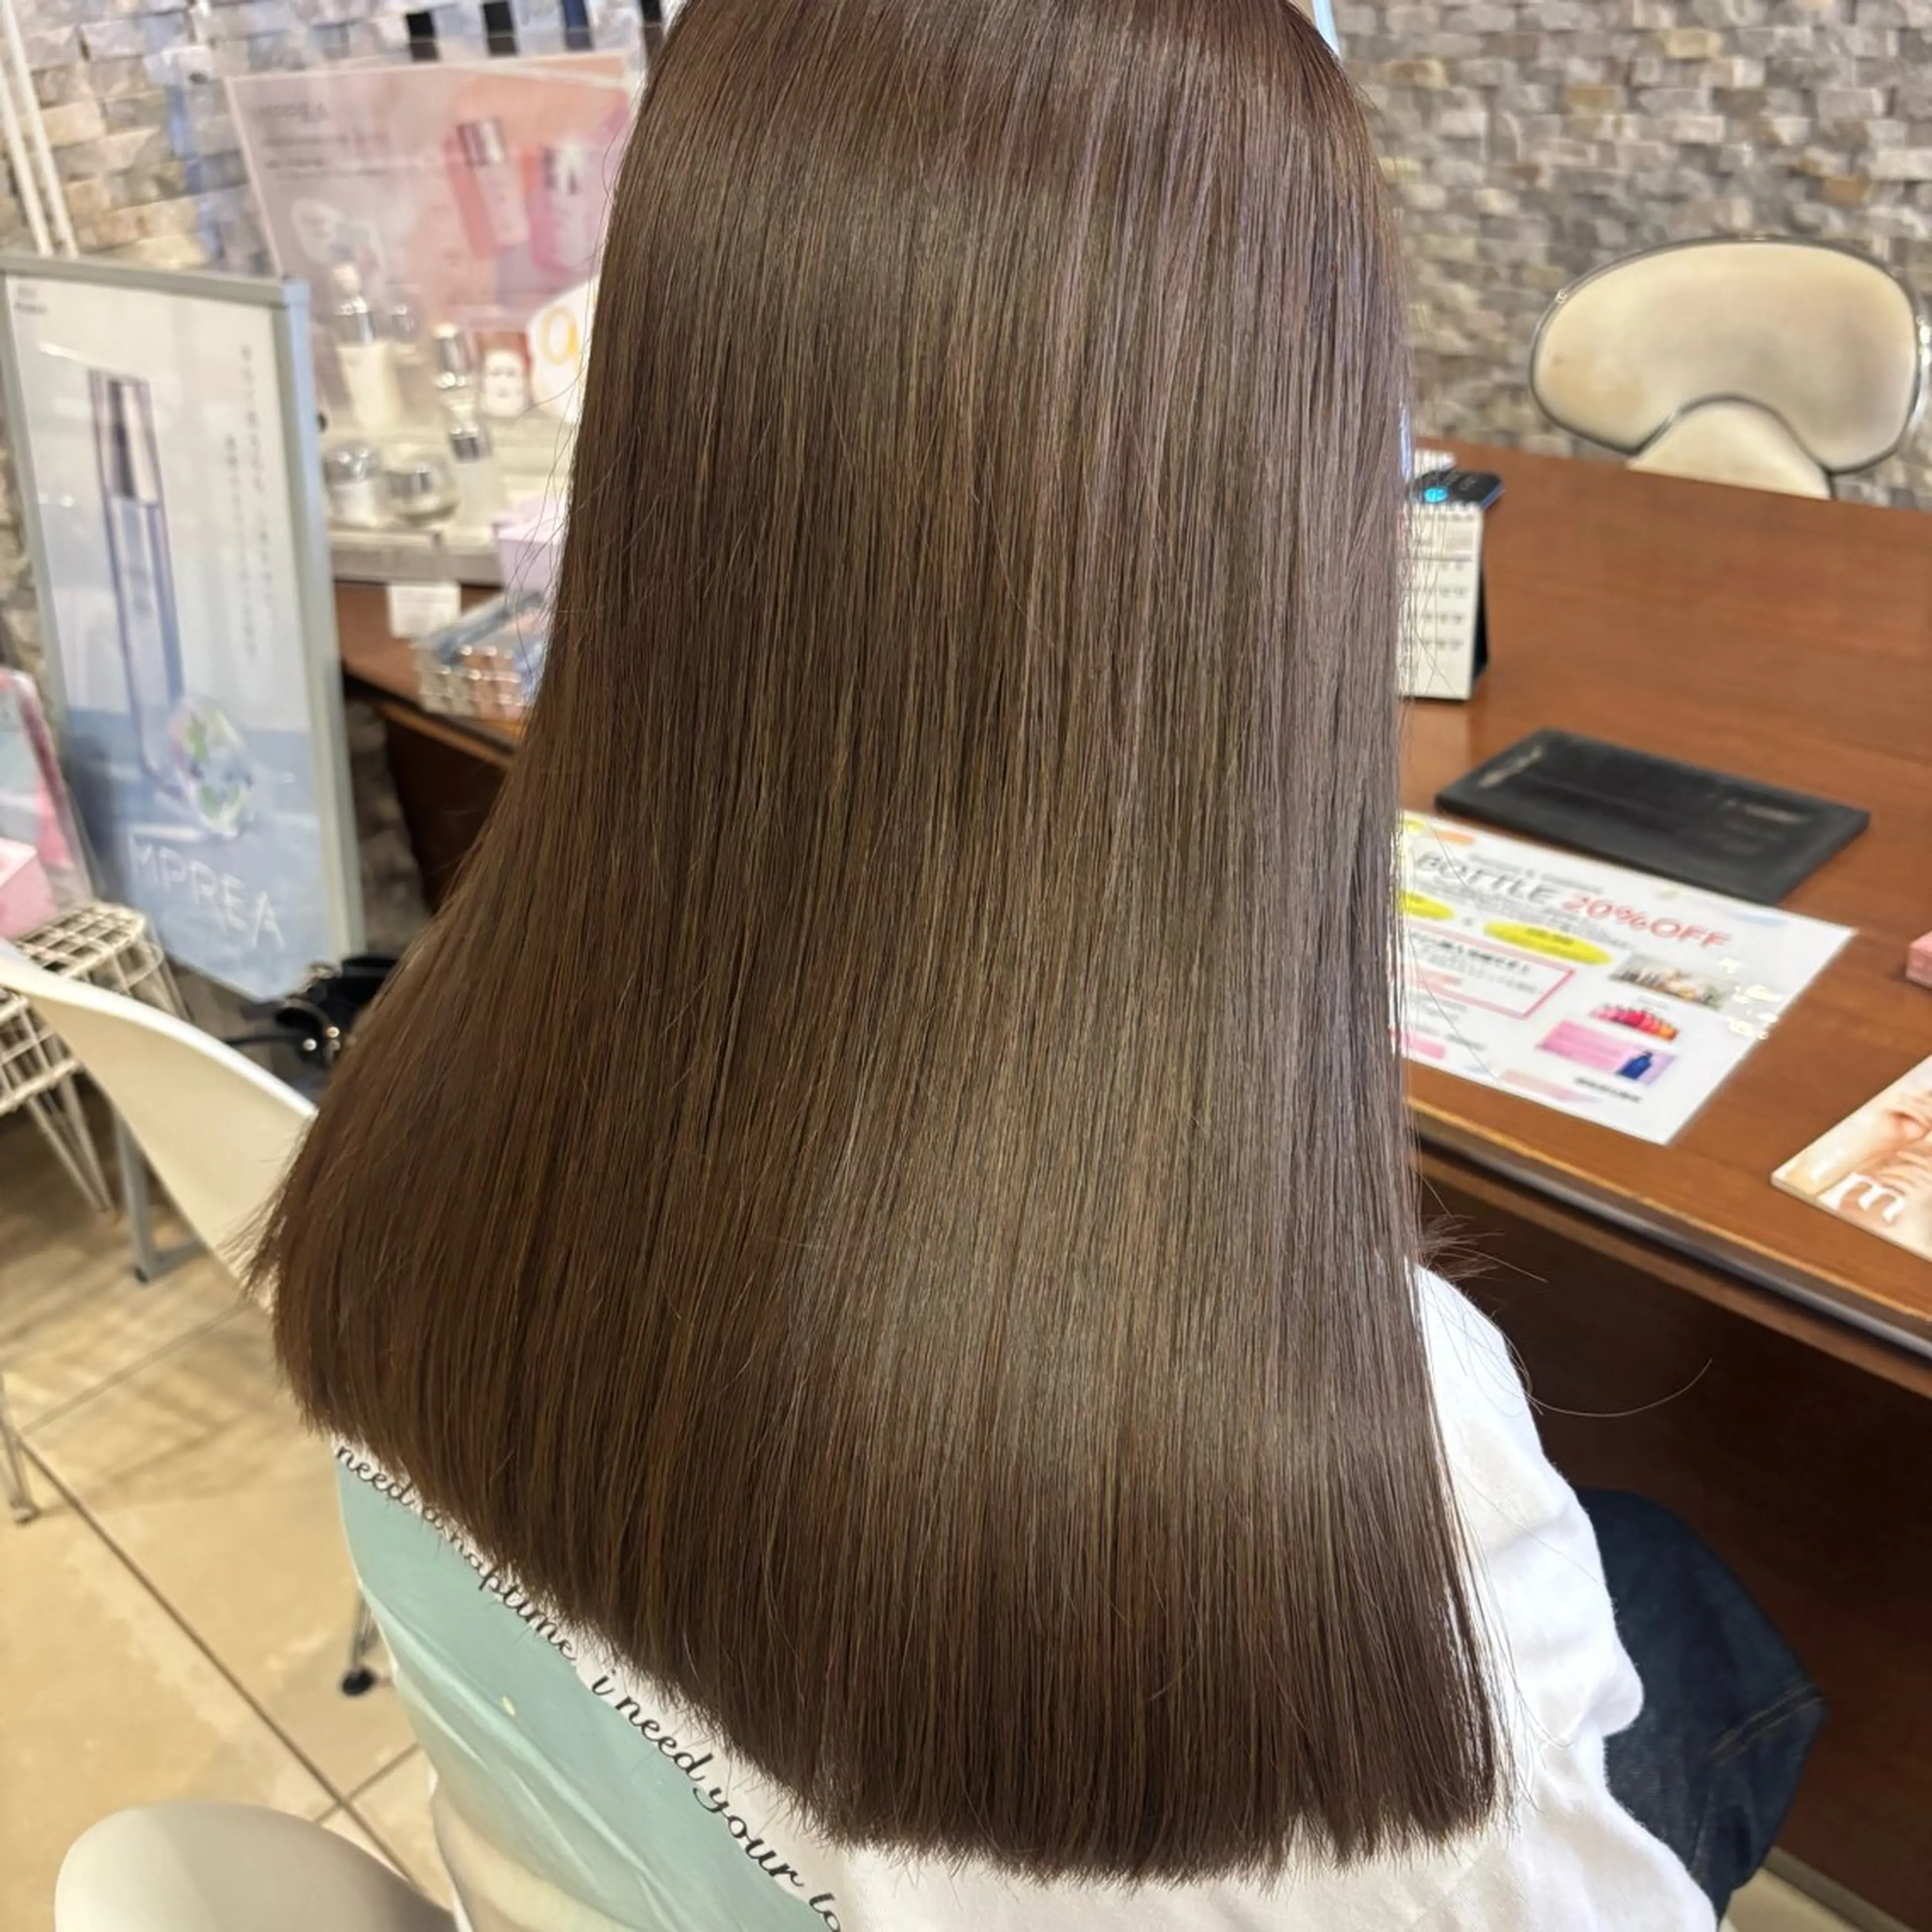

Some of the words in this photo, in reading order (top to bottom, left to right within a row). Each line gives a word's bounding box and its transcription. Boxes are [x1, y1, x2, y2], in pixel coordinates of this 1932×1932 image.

[1416, 851, 1558, 904] BOTTLE
[336, 1445, 420, 1504] need
[615, 1697, 713, 1782] need
[693, 1787, 804, 1887] your
